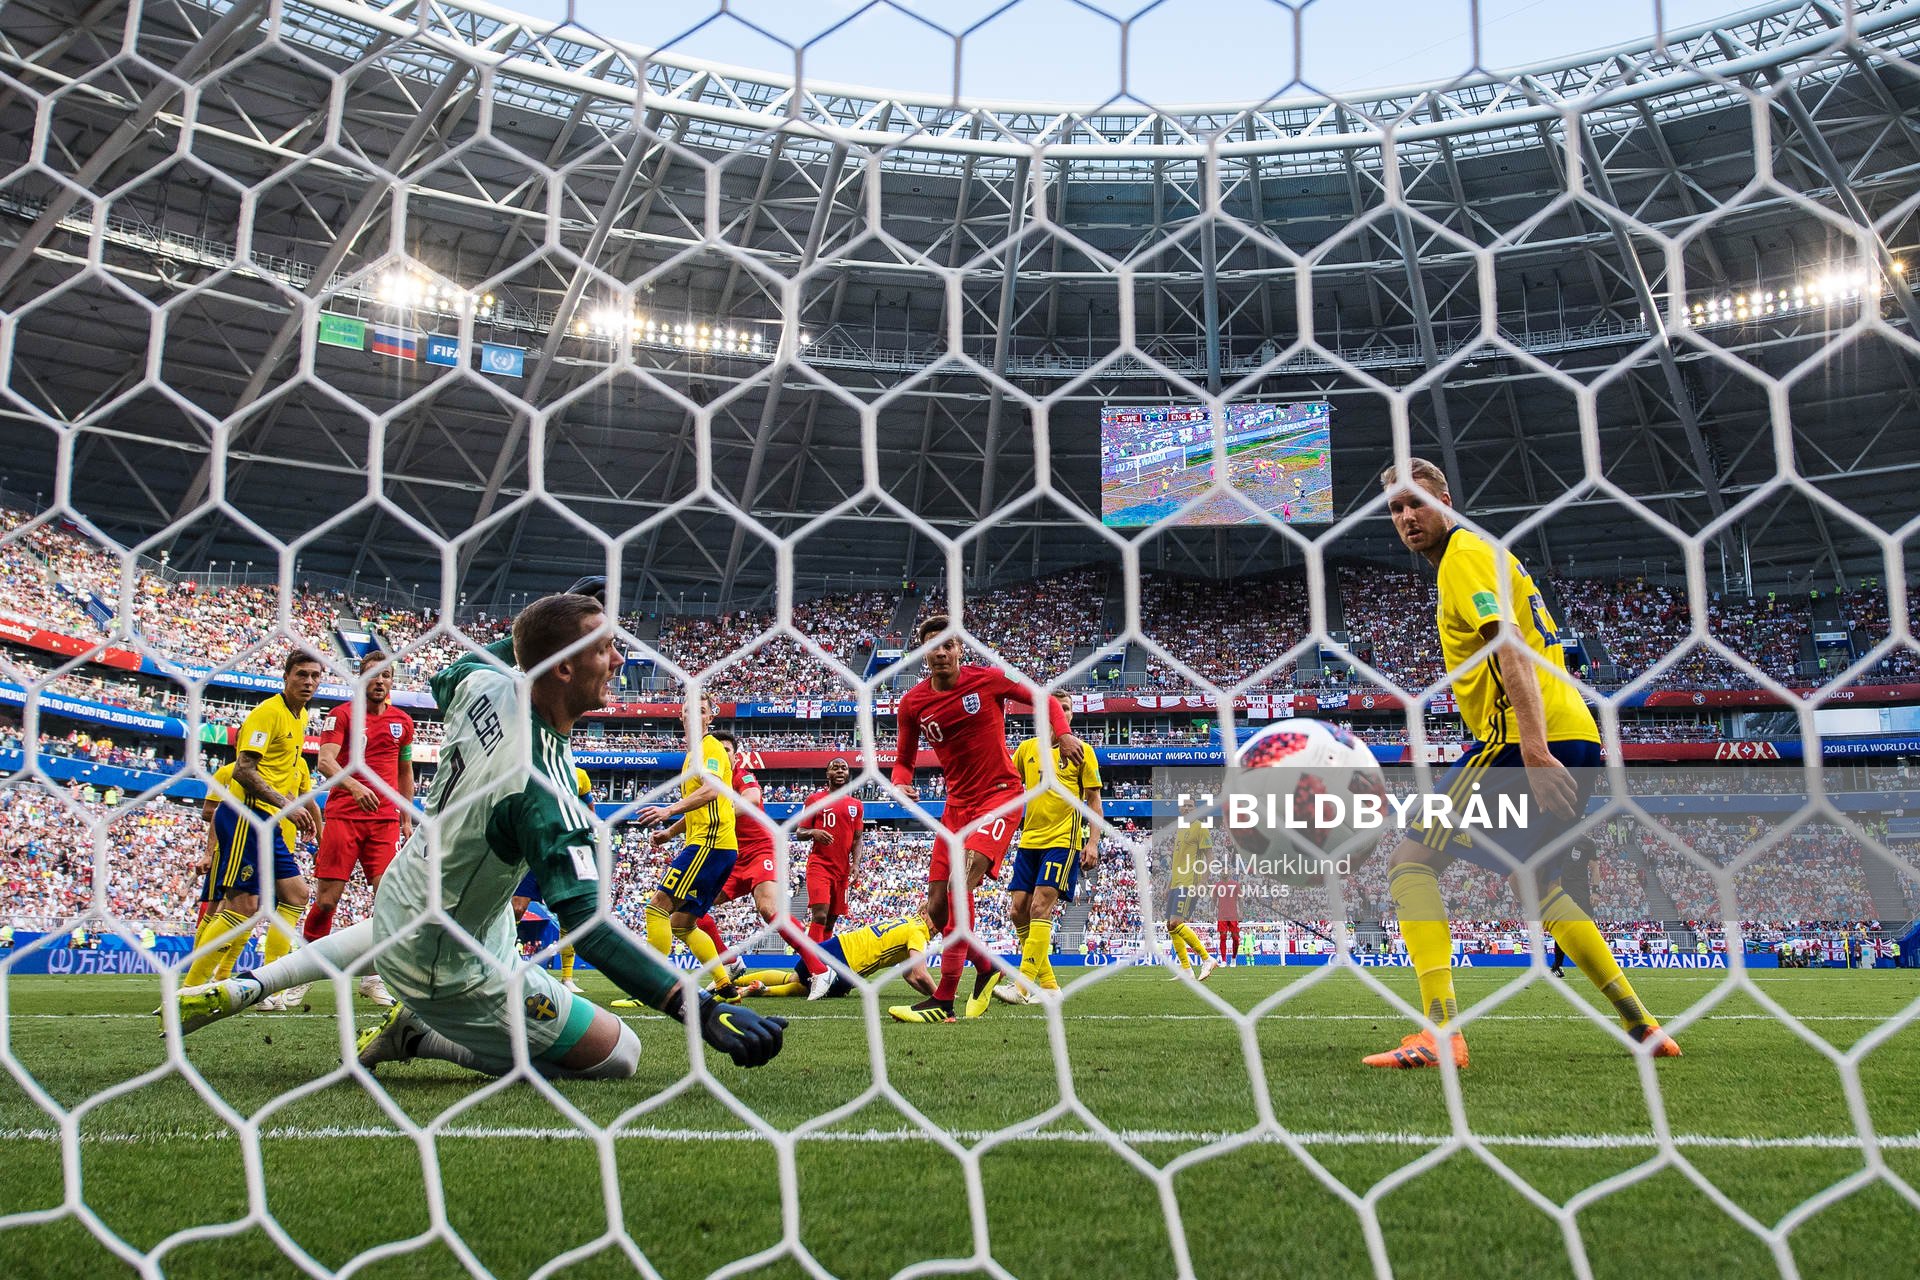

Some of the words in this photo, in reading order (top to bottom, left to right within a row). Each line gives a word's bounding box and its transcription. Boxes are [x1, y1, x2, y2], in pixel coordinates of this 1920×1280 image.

[240, 676, 254, 685] ПО
[254, 677, 285, 690] ФУТБО
[318, 687, 338, 697] 2018
[96, 708, 111, 720] FIFA
[838, 705, 852, 713] ПО
[467, 694, 504, 758] OLSEN
[1823, 745, 1846, 754] 2018
[1847, 744, 1869, 753] FIFA
[1870, 742, 1907, 751] WORLD
[603, 756, 622, 764] CUP
[624, 756, 658, 765] RUSSIA
[1107, 752, 1163, 760] ЧЕМПИОНАТ
[1165, 752, 1193, 760] МИРА
[1194, 752, 1208, 760] ПО
[823, 811, 836, 828] 10
[976, 813, 1006, 841] 20
[763, 858, 774, 872] 6
[1044, 861, 1063, 883] 17
[659, 867, 682, 890] 16
[77, 949, 116, 975] 万达
[1650, 954, 1726, 968] WANDA
